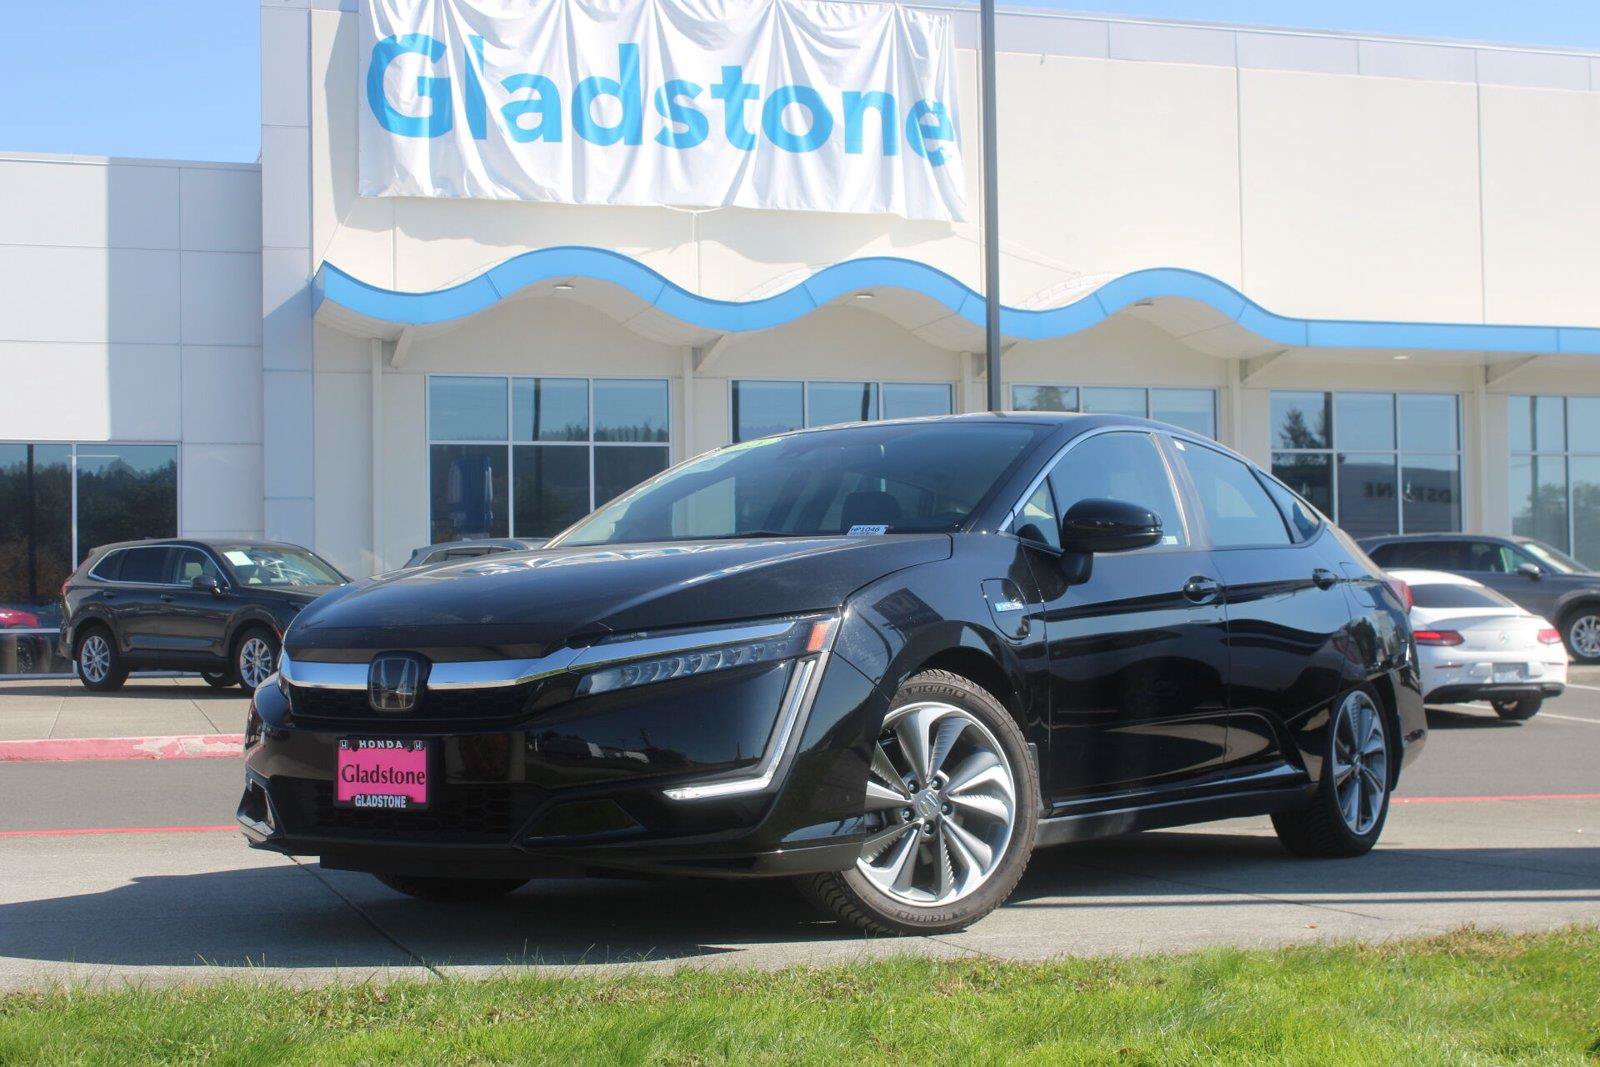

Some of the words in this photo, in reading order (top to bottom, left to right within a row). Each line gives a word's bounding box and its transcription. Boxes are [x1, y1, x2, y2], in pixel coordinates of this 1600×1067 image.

[366, 33, 955, 168] Gladstone
[359, 740, 403, 748] HONDA
[341, 764, 426, 785] Gladstone
[355, 794, 406, 808] GLADSTONE
